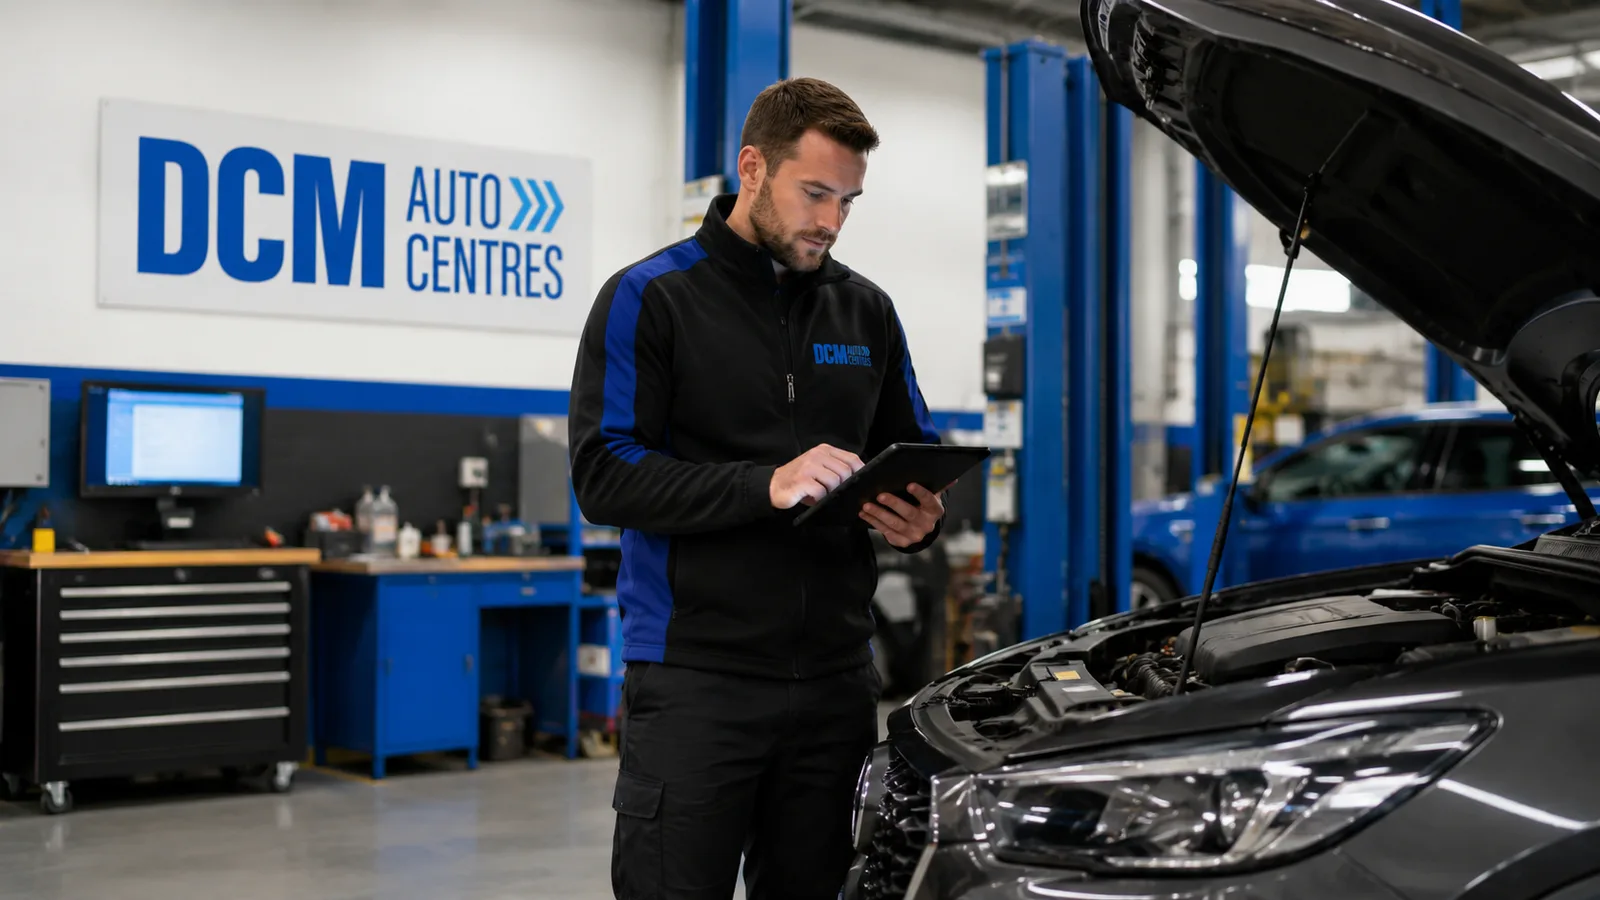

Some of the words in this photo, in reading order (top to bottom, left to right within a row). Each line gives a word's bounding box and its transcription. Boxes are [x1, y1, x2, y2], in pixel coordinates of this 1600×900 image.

[137, 136, 385, 289] DCM
[406, 166, 501, 230] AUTO
[406, 233, 563, 301] CENTRES
[813, 343, 848, 365] DCM
